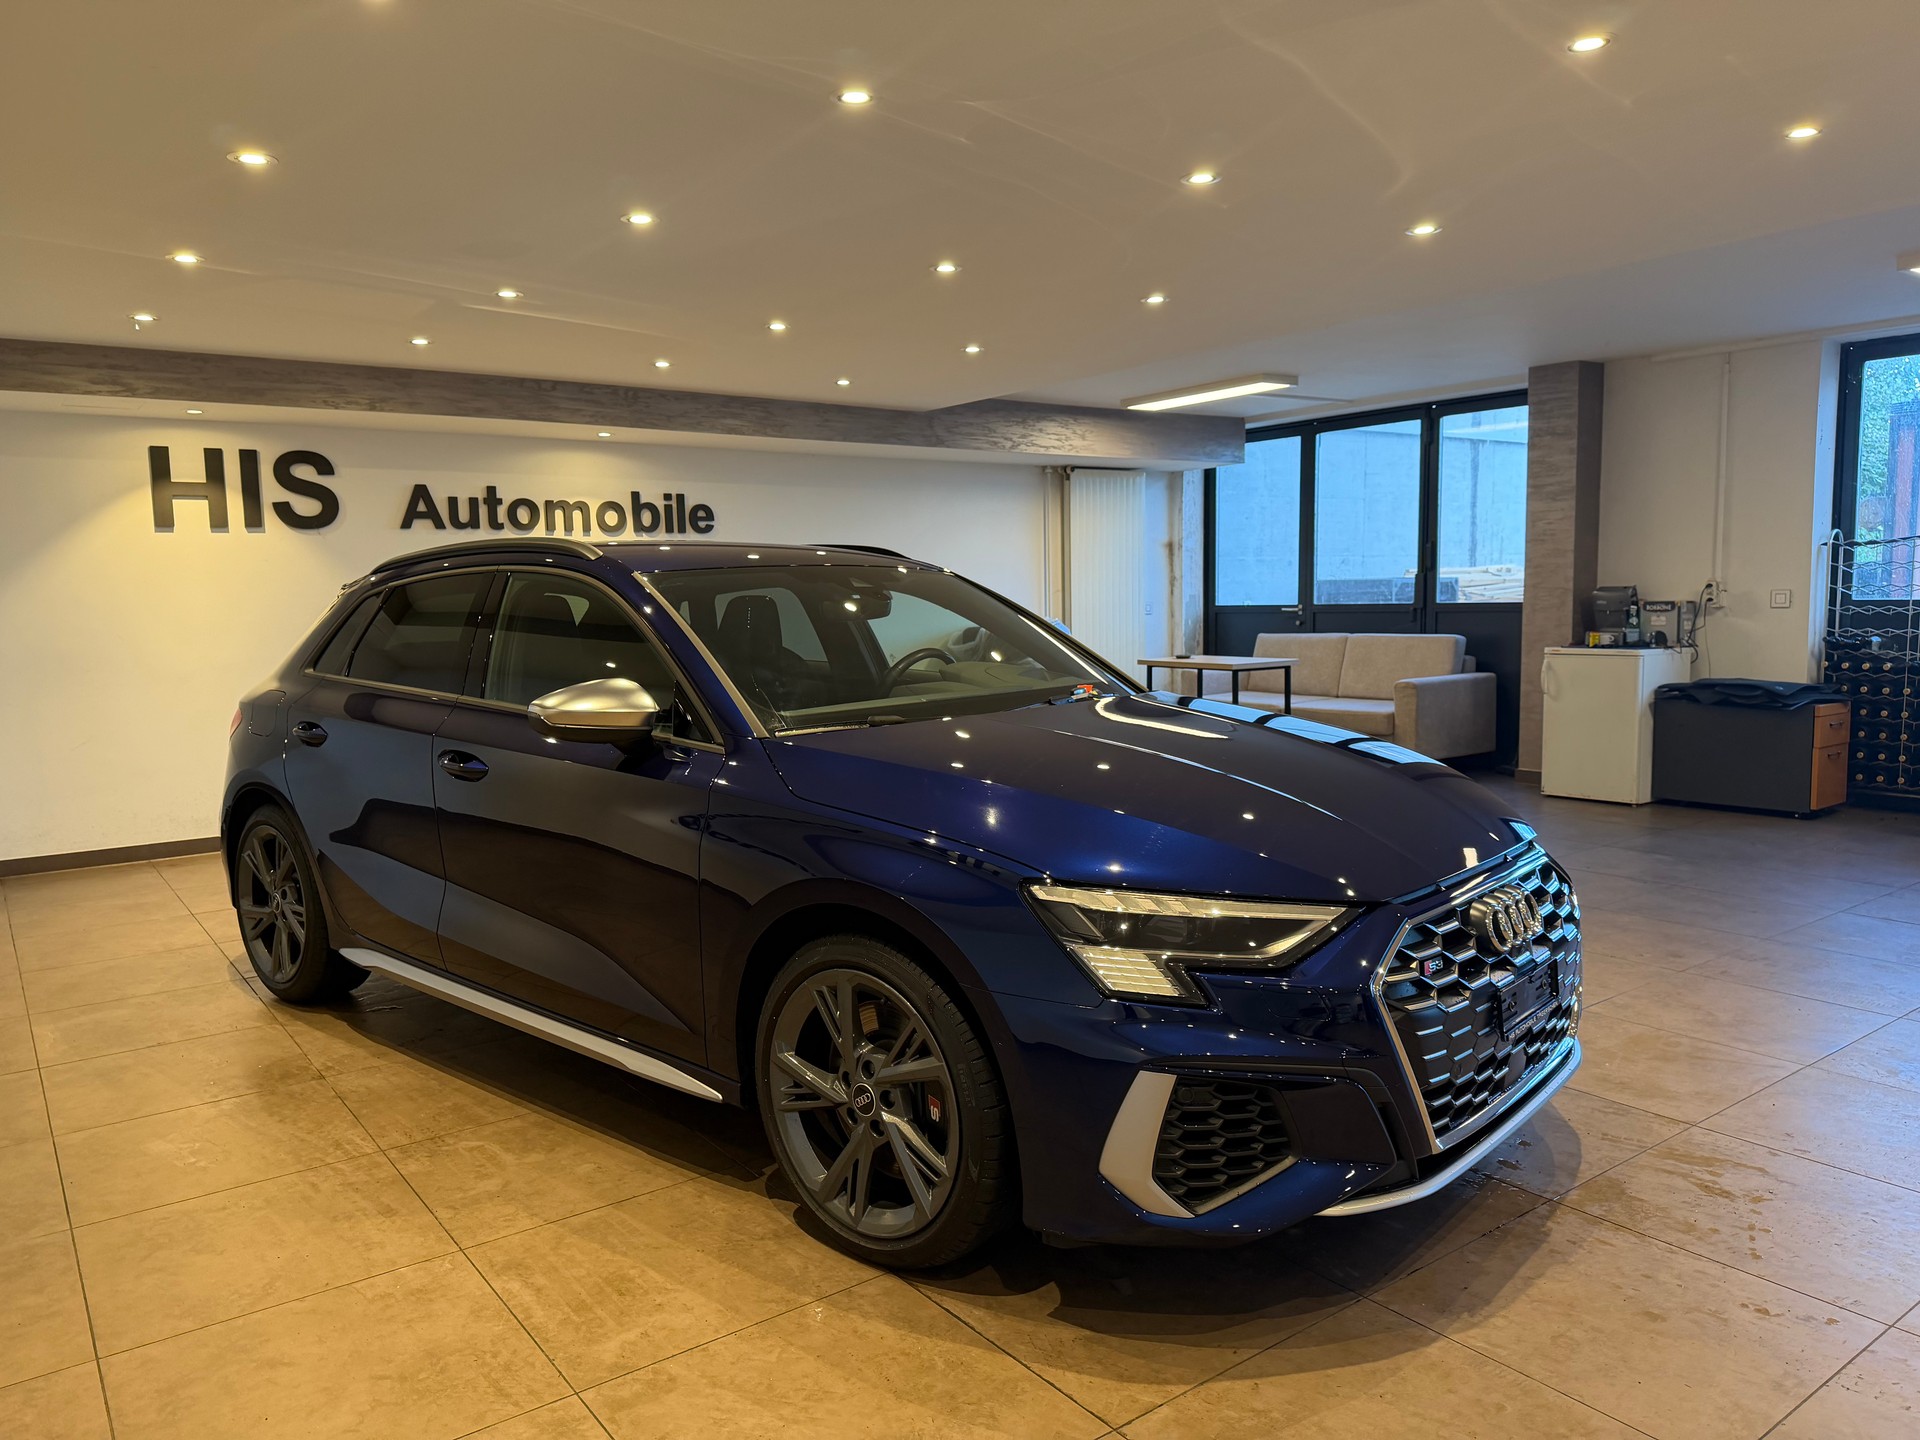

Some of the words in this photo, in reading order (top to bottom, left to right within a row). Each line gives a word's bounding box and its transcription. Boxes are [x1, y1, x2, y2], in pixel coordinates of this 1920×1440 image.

[147, 445, 340, 531] HIS
[400, 484, 716, 534] Automobile
[1428, 959, 1444, 972] S3
[930, 1105, 940, 1122] S
